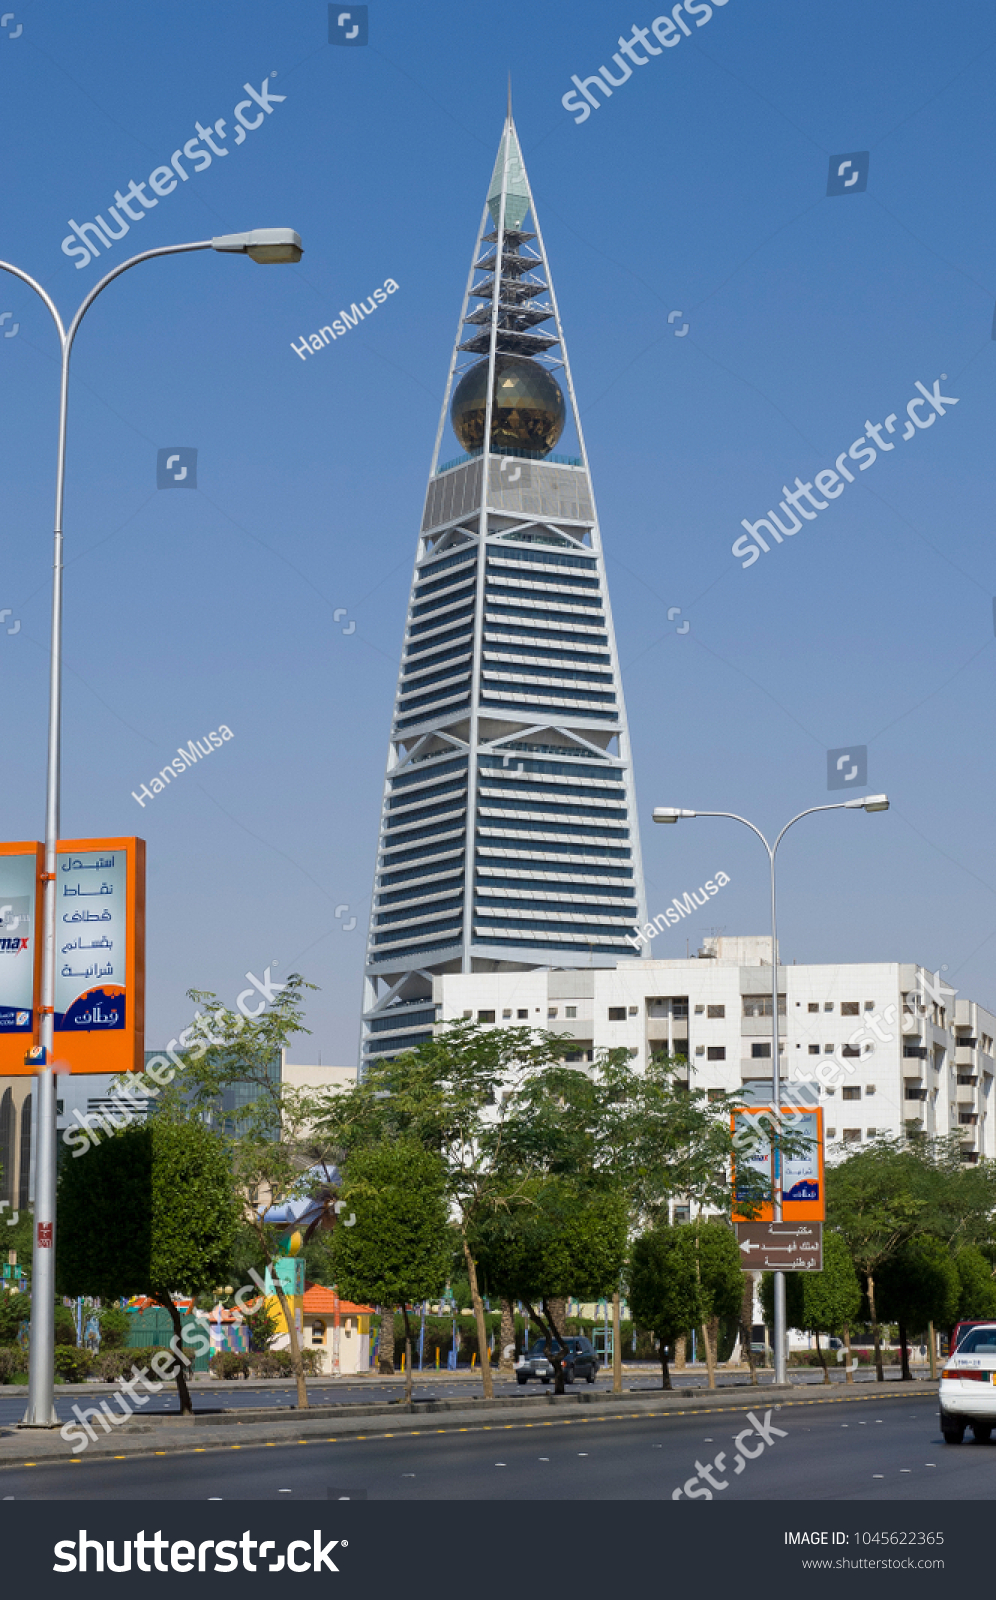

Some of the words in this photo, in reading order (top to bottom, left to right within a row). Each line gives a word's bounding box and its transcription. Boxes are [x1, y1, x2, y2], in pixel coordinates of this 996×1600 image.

[61, 855, 115, 872] استبدل
[63, 882, 113, 897] نقاط
[63, 908, 112, 923] قطاف
[768, 1223, 813, 1237] مكتبة
[761, 1240, 798, 1254] فهد
[764, 1256, 817, 1270] الوطنية
